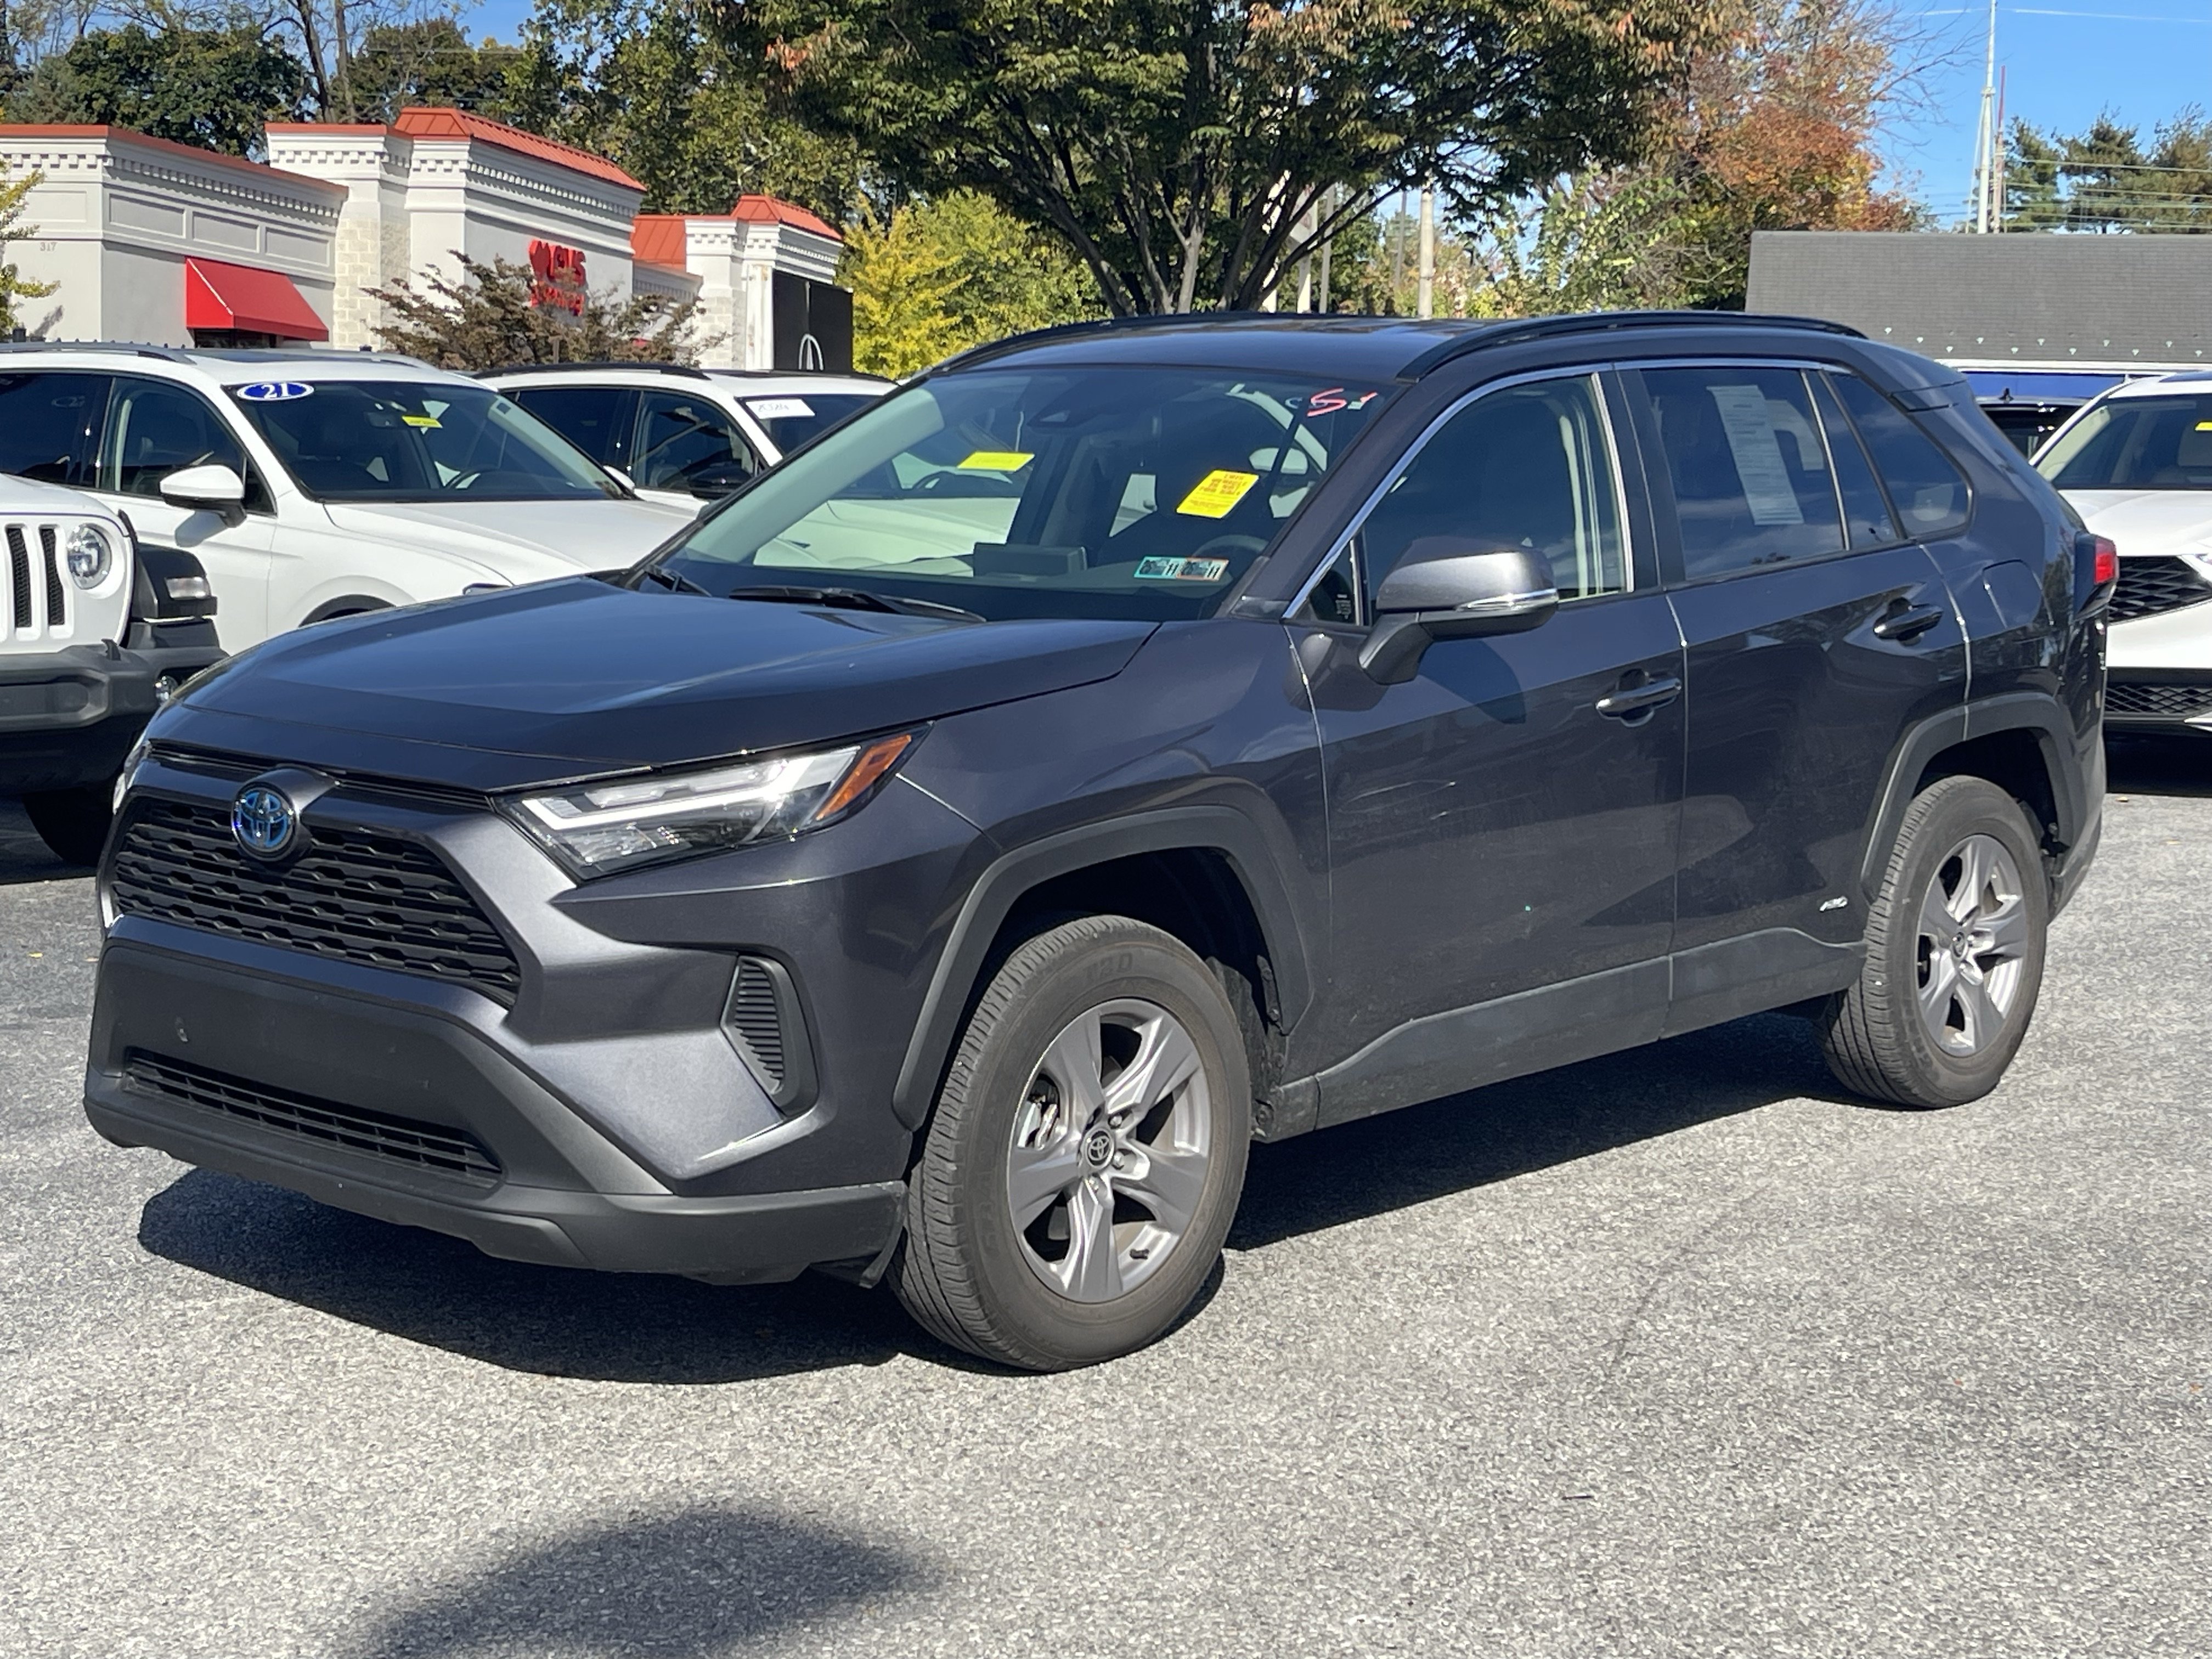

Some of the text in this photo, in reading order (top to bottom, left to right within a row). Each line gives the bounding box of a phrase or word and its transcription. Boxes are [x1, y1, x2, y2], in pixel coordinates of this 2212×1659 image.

[40, 241, 57, 252] 317
[261, 383, 290, 399] 21
[1165, 563, 1180, 576] 11
[1207, 566, 1221, 579] 11
